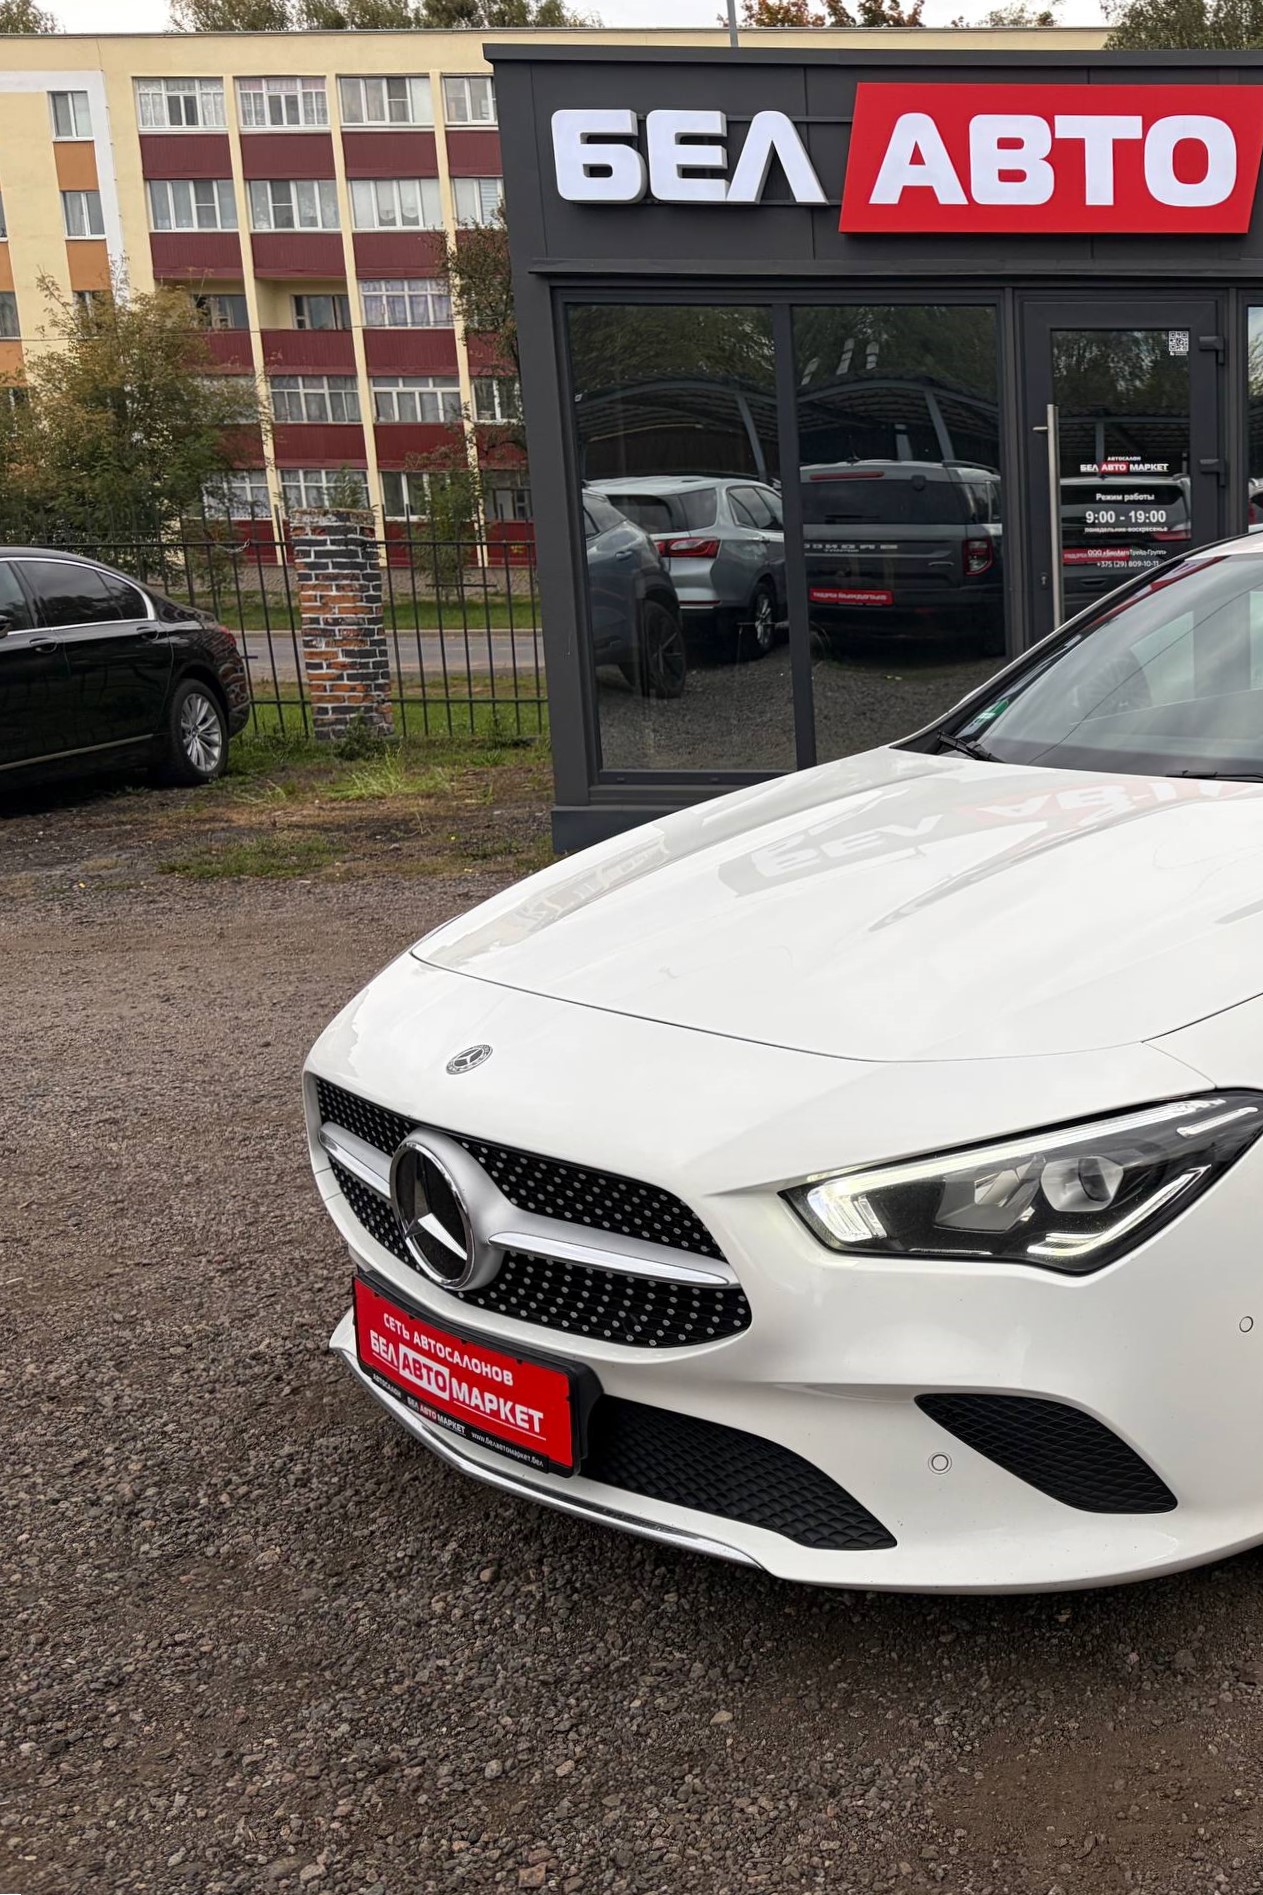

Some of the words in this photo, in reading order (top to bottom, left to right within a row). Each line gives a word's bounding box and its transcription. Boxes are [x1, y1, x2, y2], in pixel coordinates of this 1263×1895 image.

[551, 109, 829, 204] БЕЛ
[869, 112, 1238, 207] АВТО
[1080, 464, 1099, 472] БЕЛ
[1130, 464, 1169, 472] МАРКЕТ
[1124, 493, 1154, 502] работы
[1085, 510, 1116, 524] 9:00
[1129, 510, 1166, 523] 19:00
[383, 1312, 410, 1340] СЕТЬ
[413, 1330, 514, 1387] АВТОСАЛОНОВ
[369, 1329, 398, 1368] БЕЛ
[402, 1351, 447, 1393] АВТО
[452, 1377, 544, 1434] МАРКЕТ
[437, 1412, 466, 1434] МАРКЕТ
